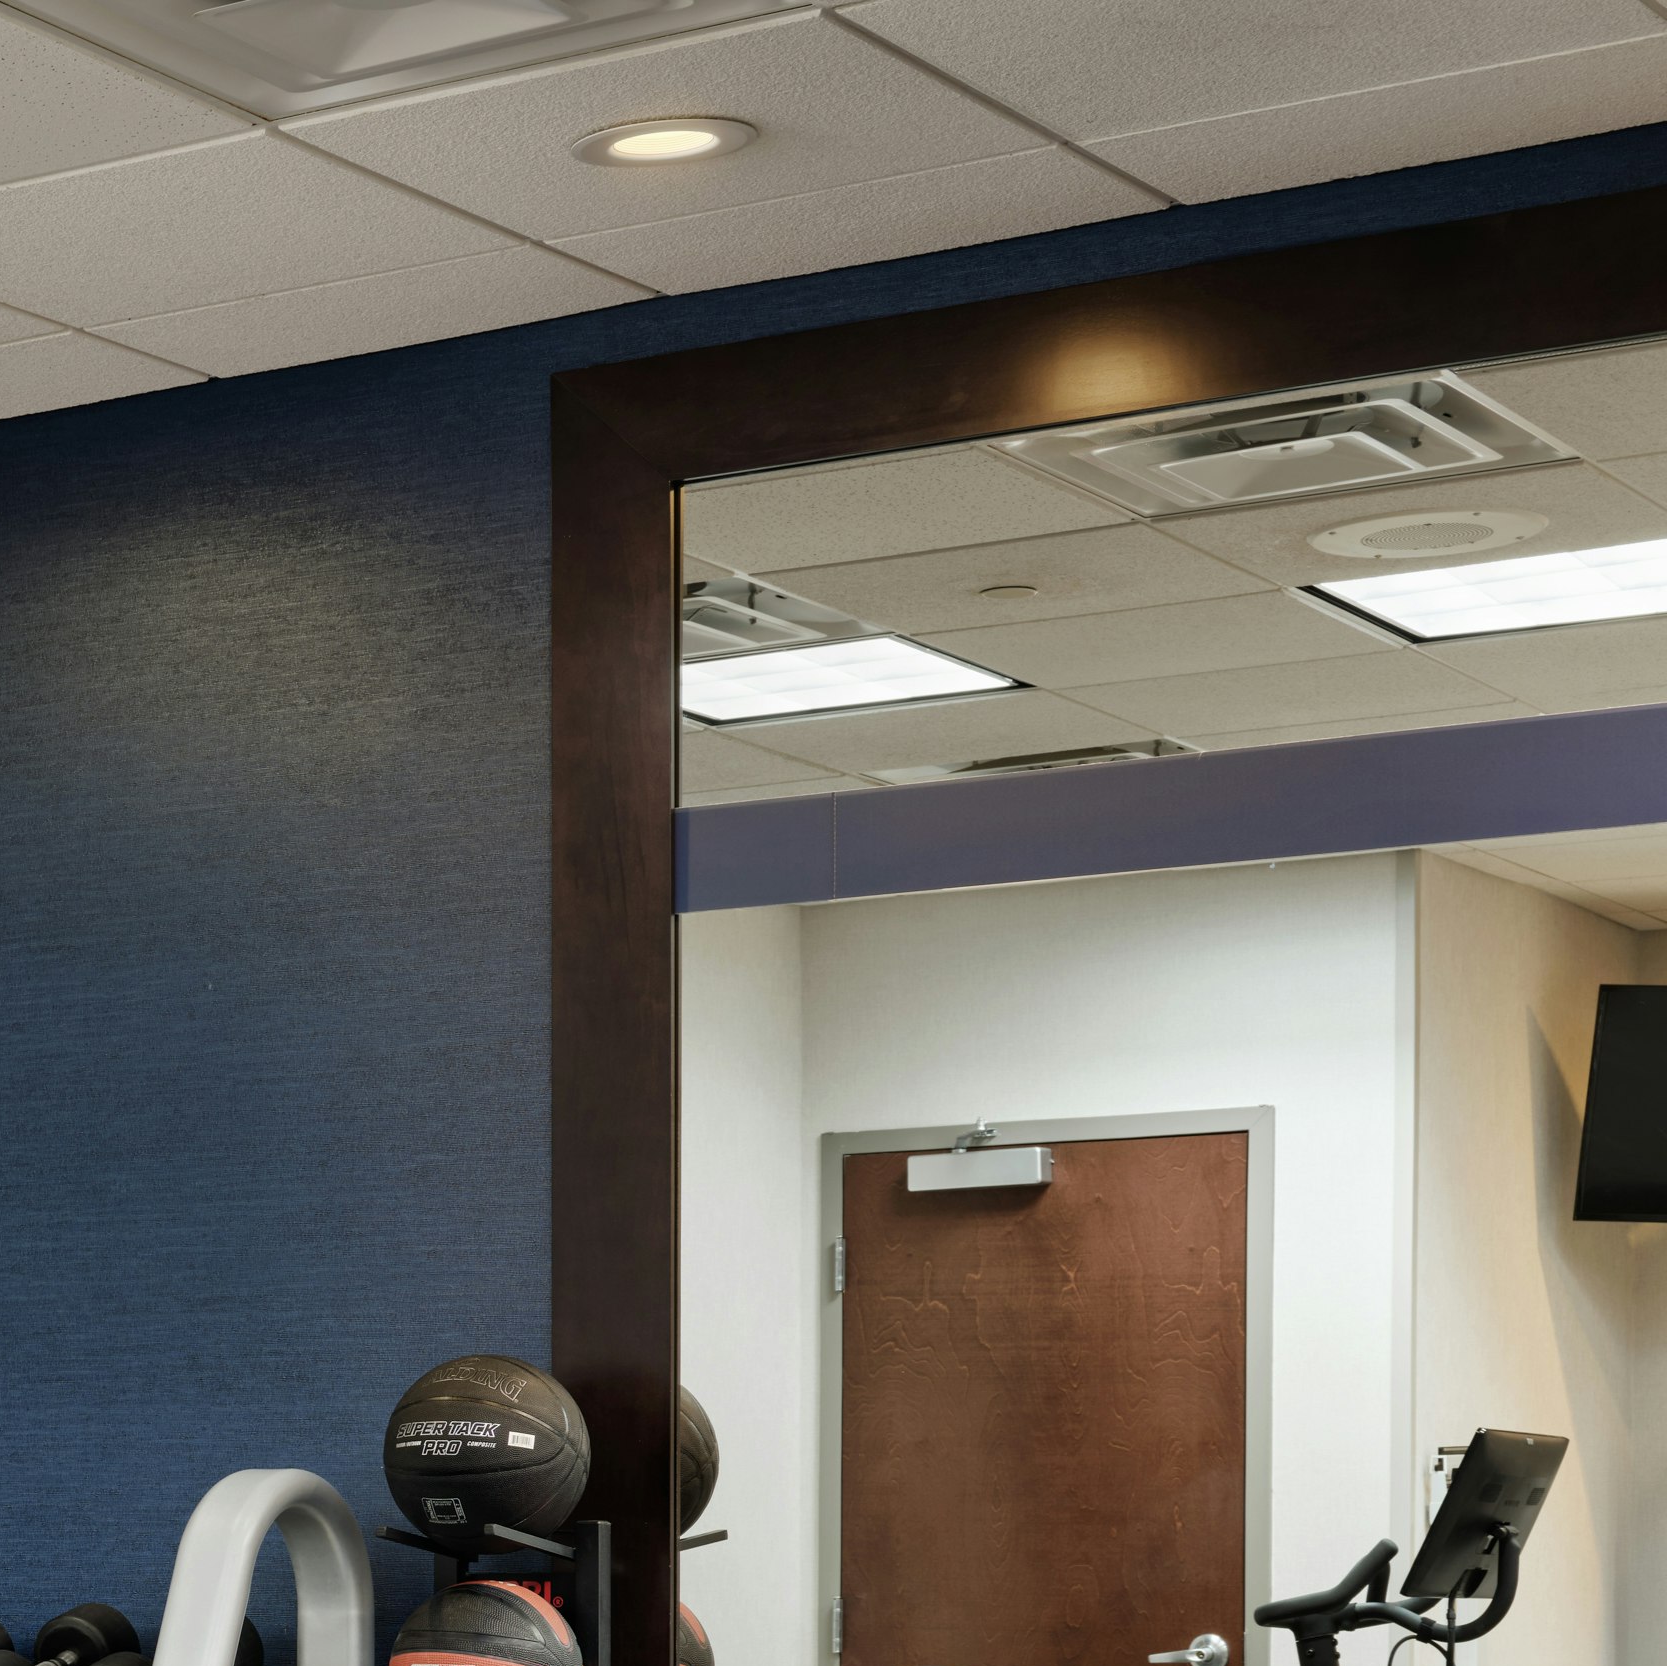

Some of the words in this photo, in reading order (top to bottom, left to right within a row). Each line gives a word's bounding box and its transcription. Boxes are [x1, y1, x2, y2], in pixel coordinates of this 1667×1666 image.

[424, 1366, 528, 1402] ALDING
[396, 1421, 447, 1438] SUPER
[448, 1421, 501, 1437] TACK
[422, 1440, 462, 1455] PRO
[466, 1440, 497, 1449] COMPOSITE
